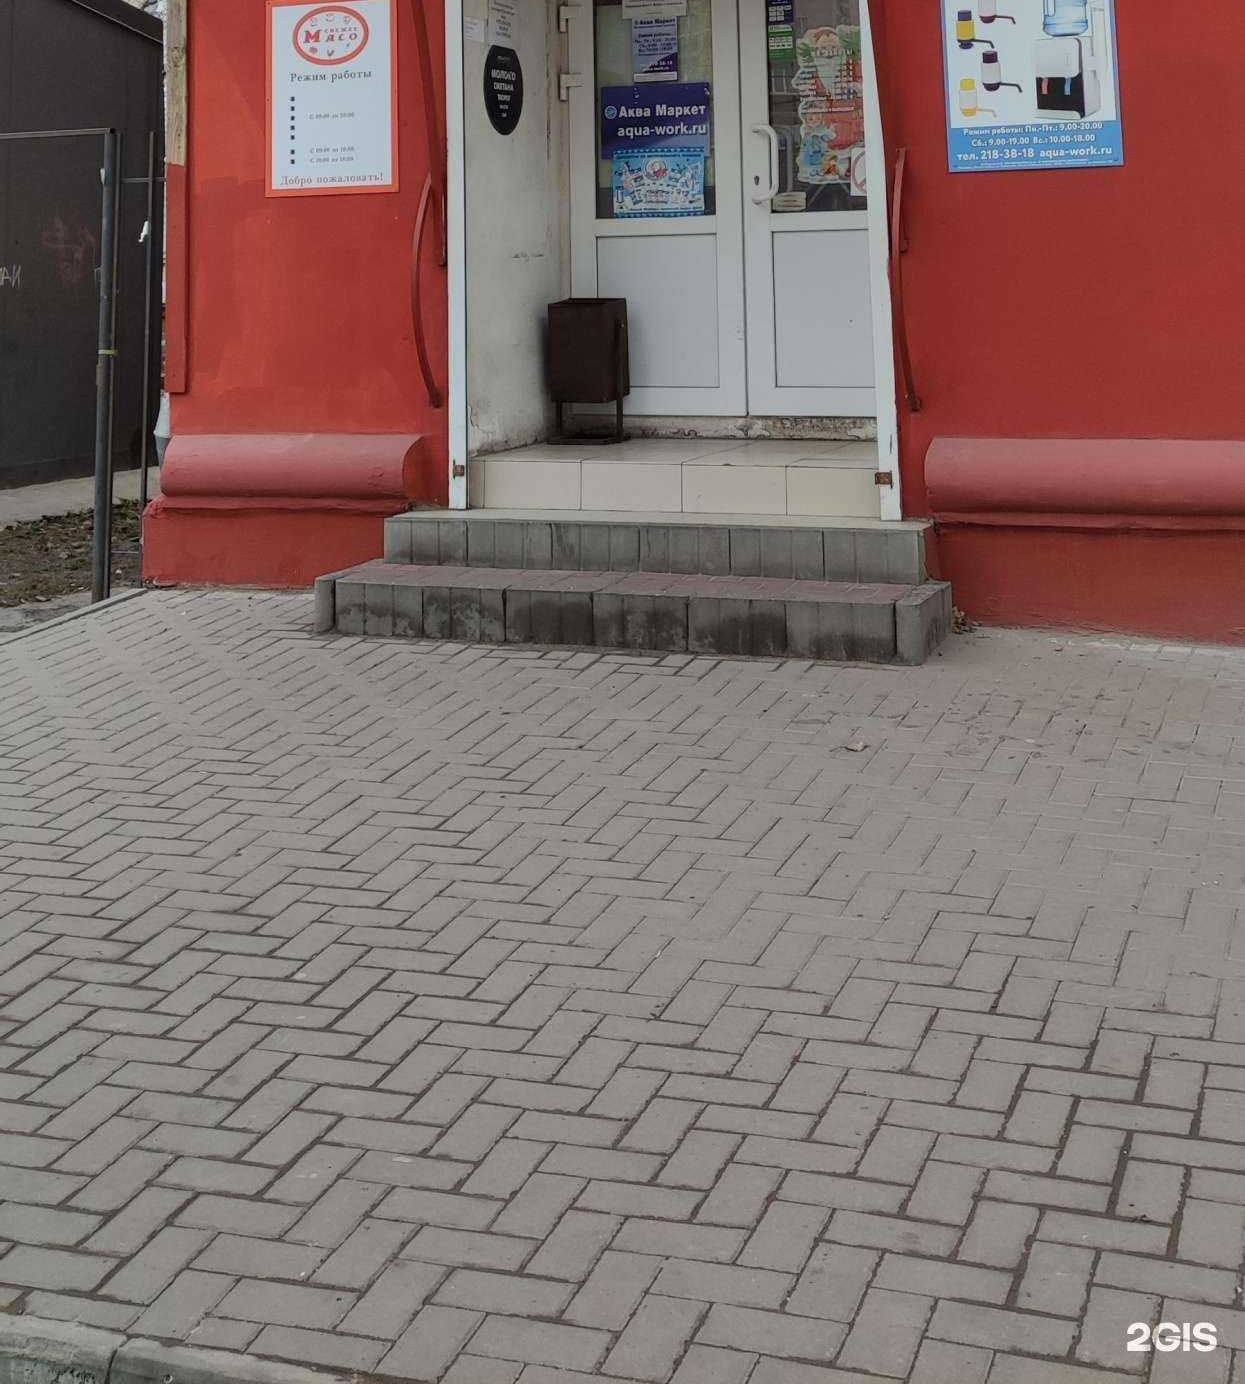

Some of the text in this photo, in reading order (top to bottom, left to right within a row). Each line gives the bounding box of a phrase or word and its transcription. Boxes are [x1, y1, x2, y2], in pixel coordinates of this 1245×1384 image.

[290, 70, 372, 84] Режим работы
[618, 103, 706, 118] Аква Маркет
[617, 123, 707, 139] aqua-work.ru
[981, 148, 1035, 160] 218-38-18
[1039, 146, 1113, 159] aqua-work.ru
[280, 171, 384, 186] Добро пожаловать!
